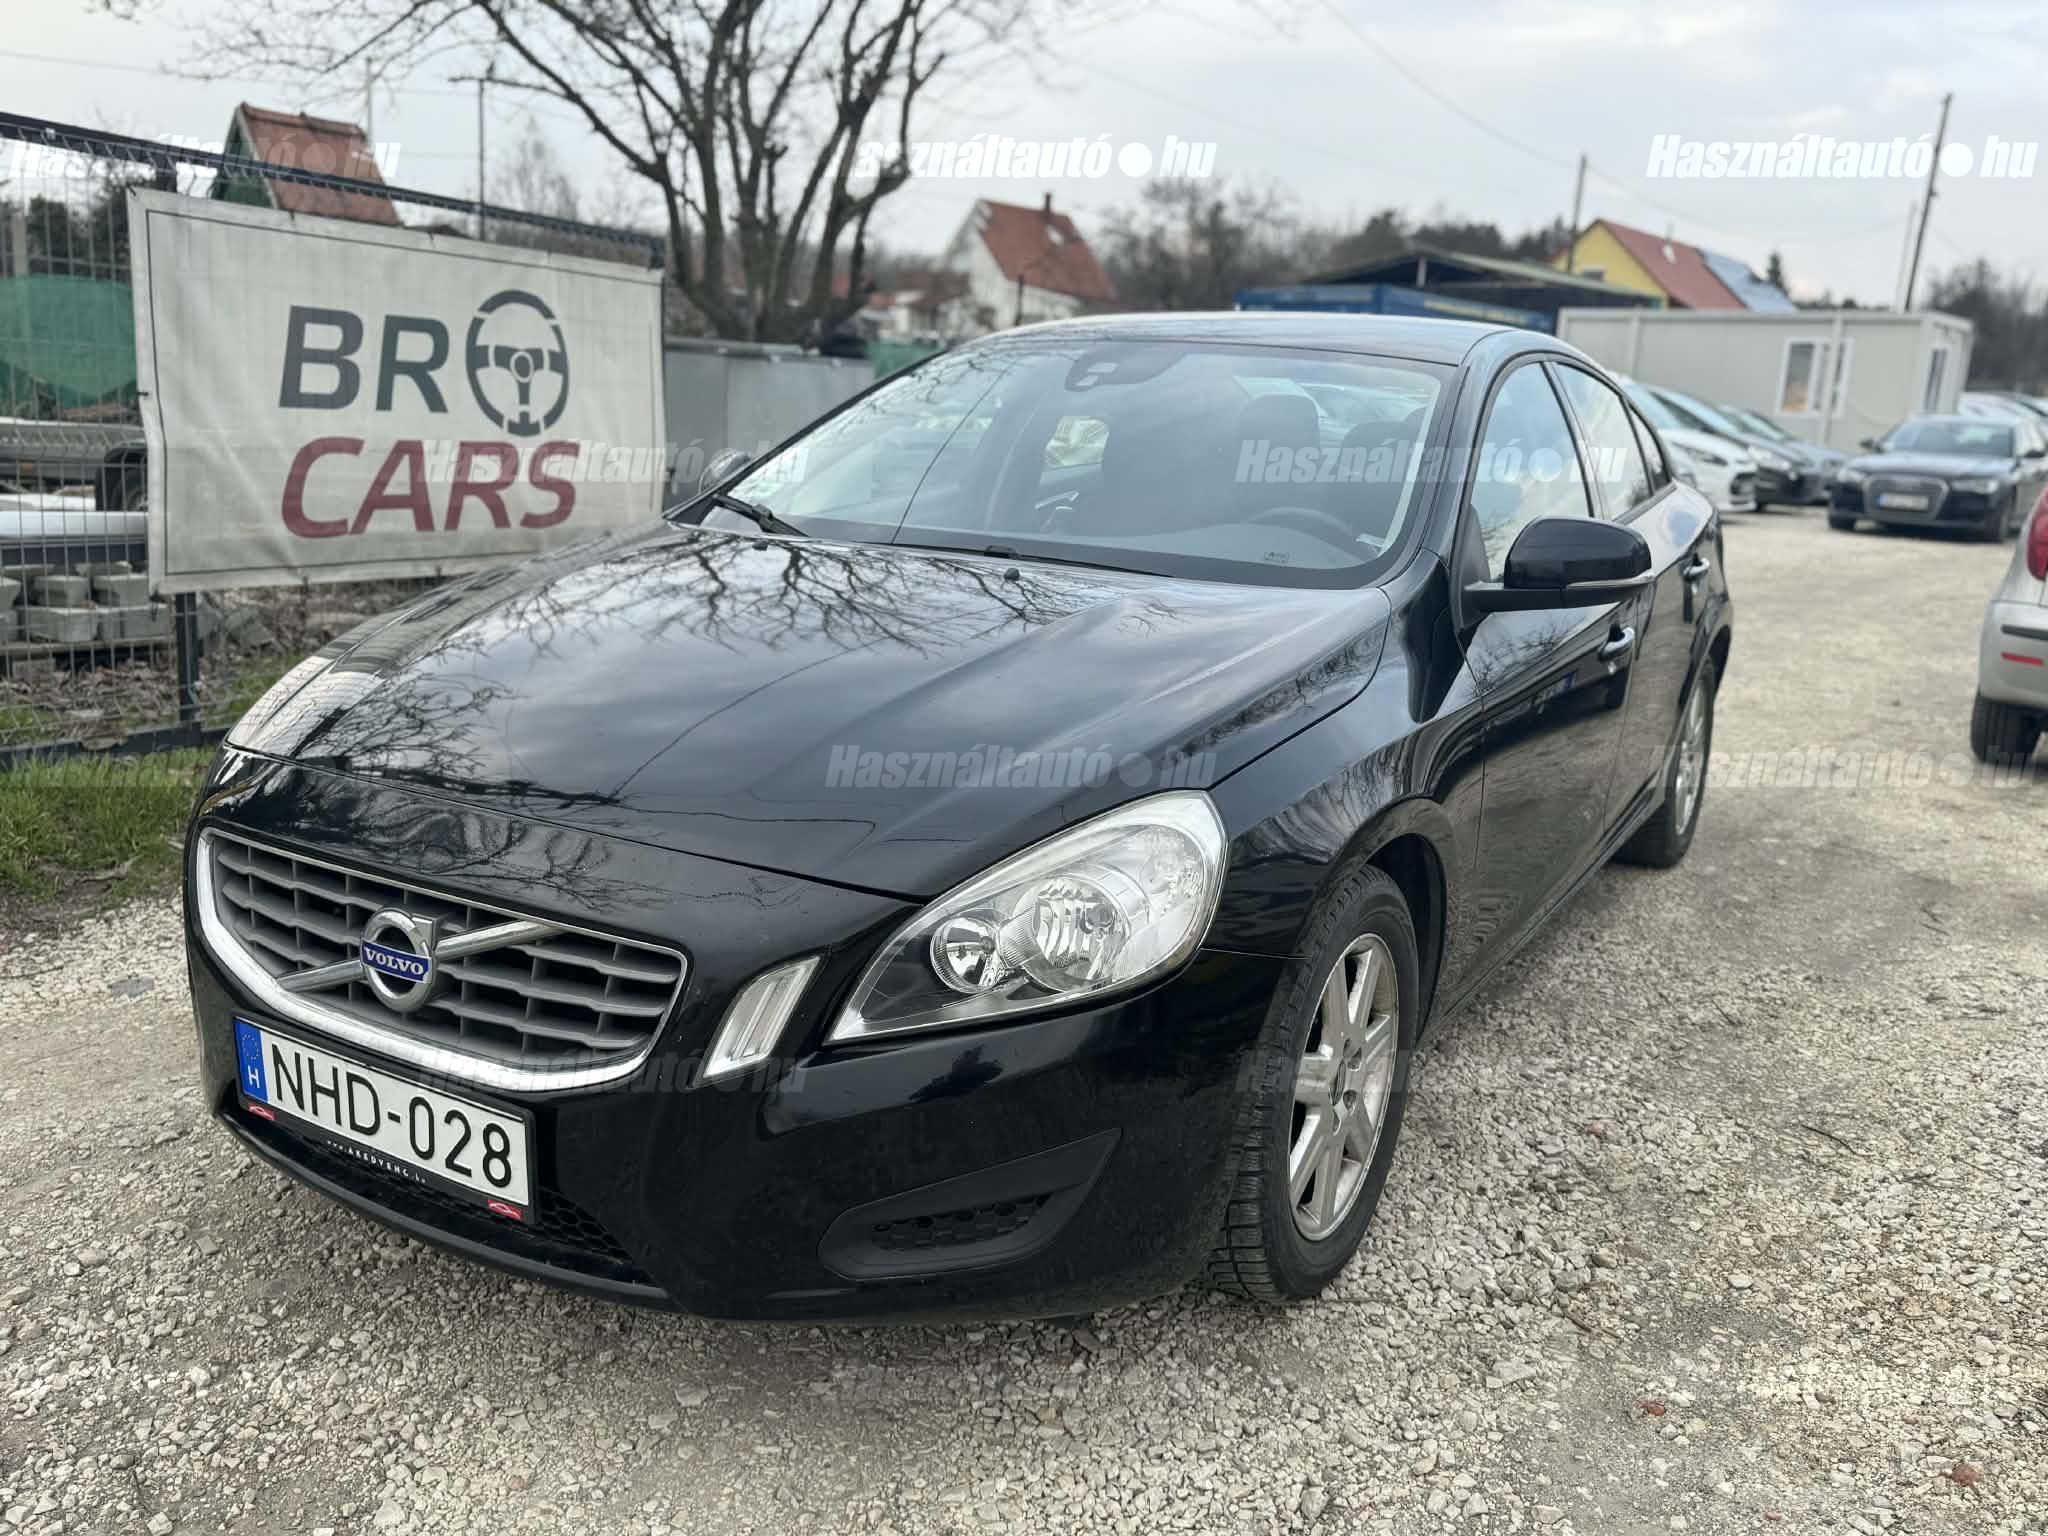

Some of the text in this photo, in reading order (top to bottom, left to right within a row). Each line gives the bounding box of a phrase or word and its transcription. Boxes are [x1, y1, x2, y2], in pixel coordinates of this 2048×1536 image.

[281, 436, 580, 538] CARS
[364, 945, 424, 975] VOLVO
[247, 1041, 512, 1188] H NHD-028
